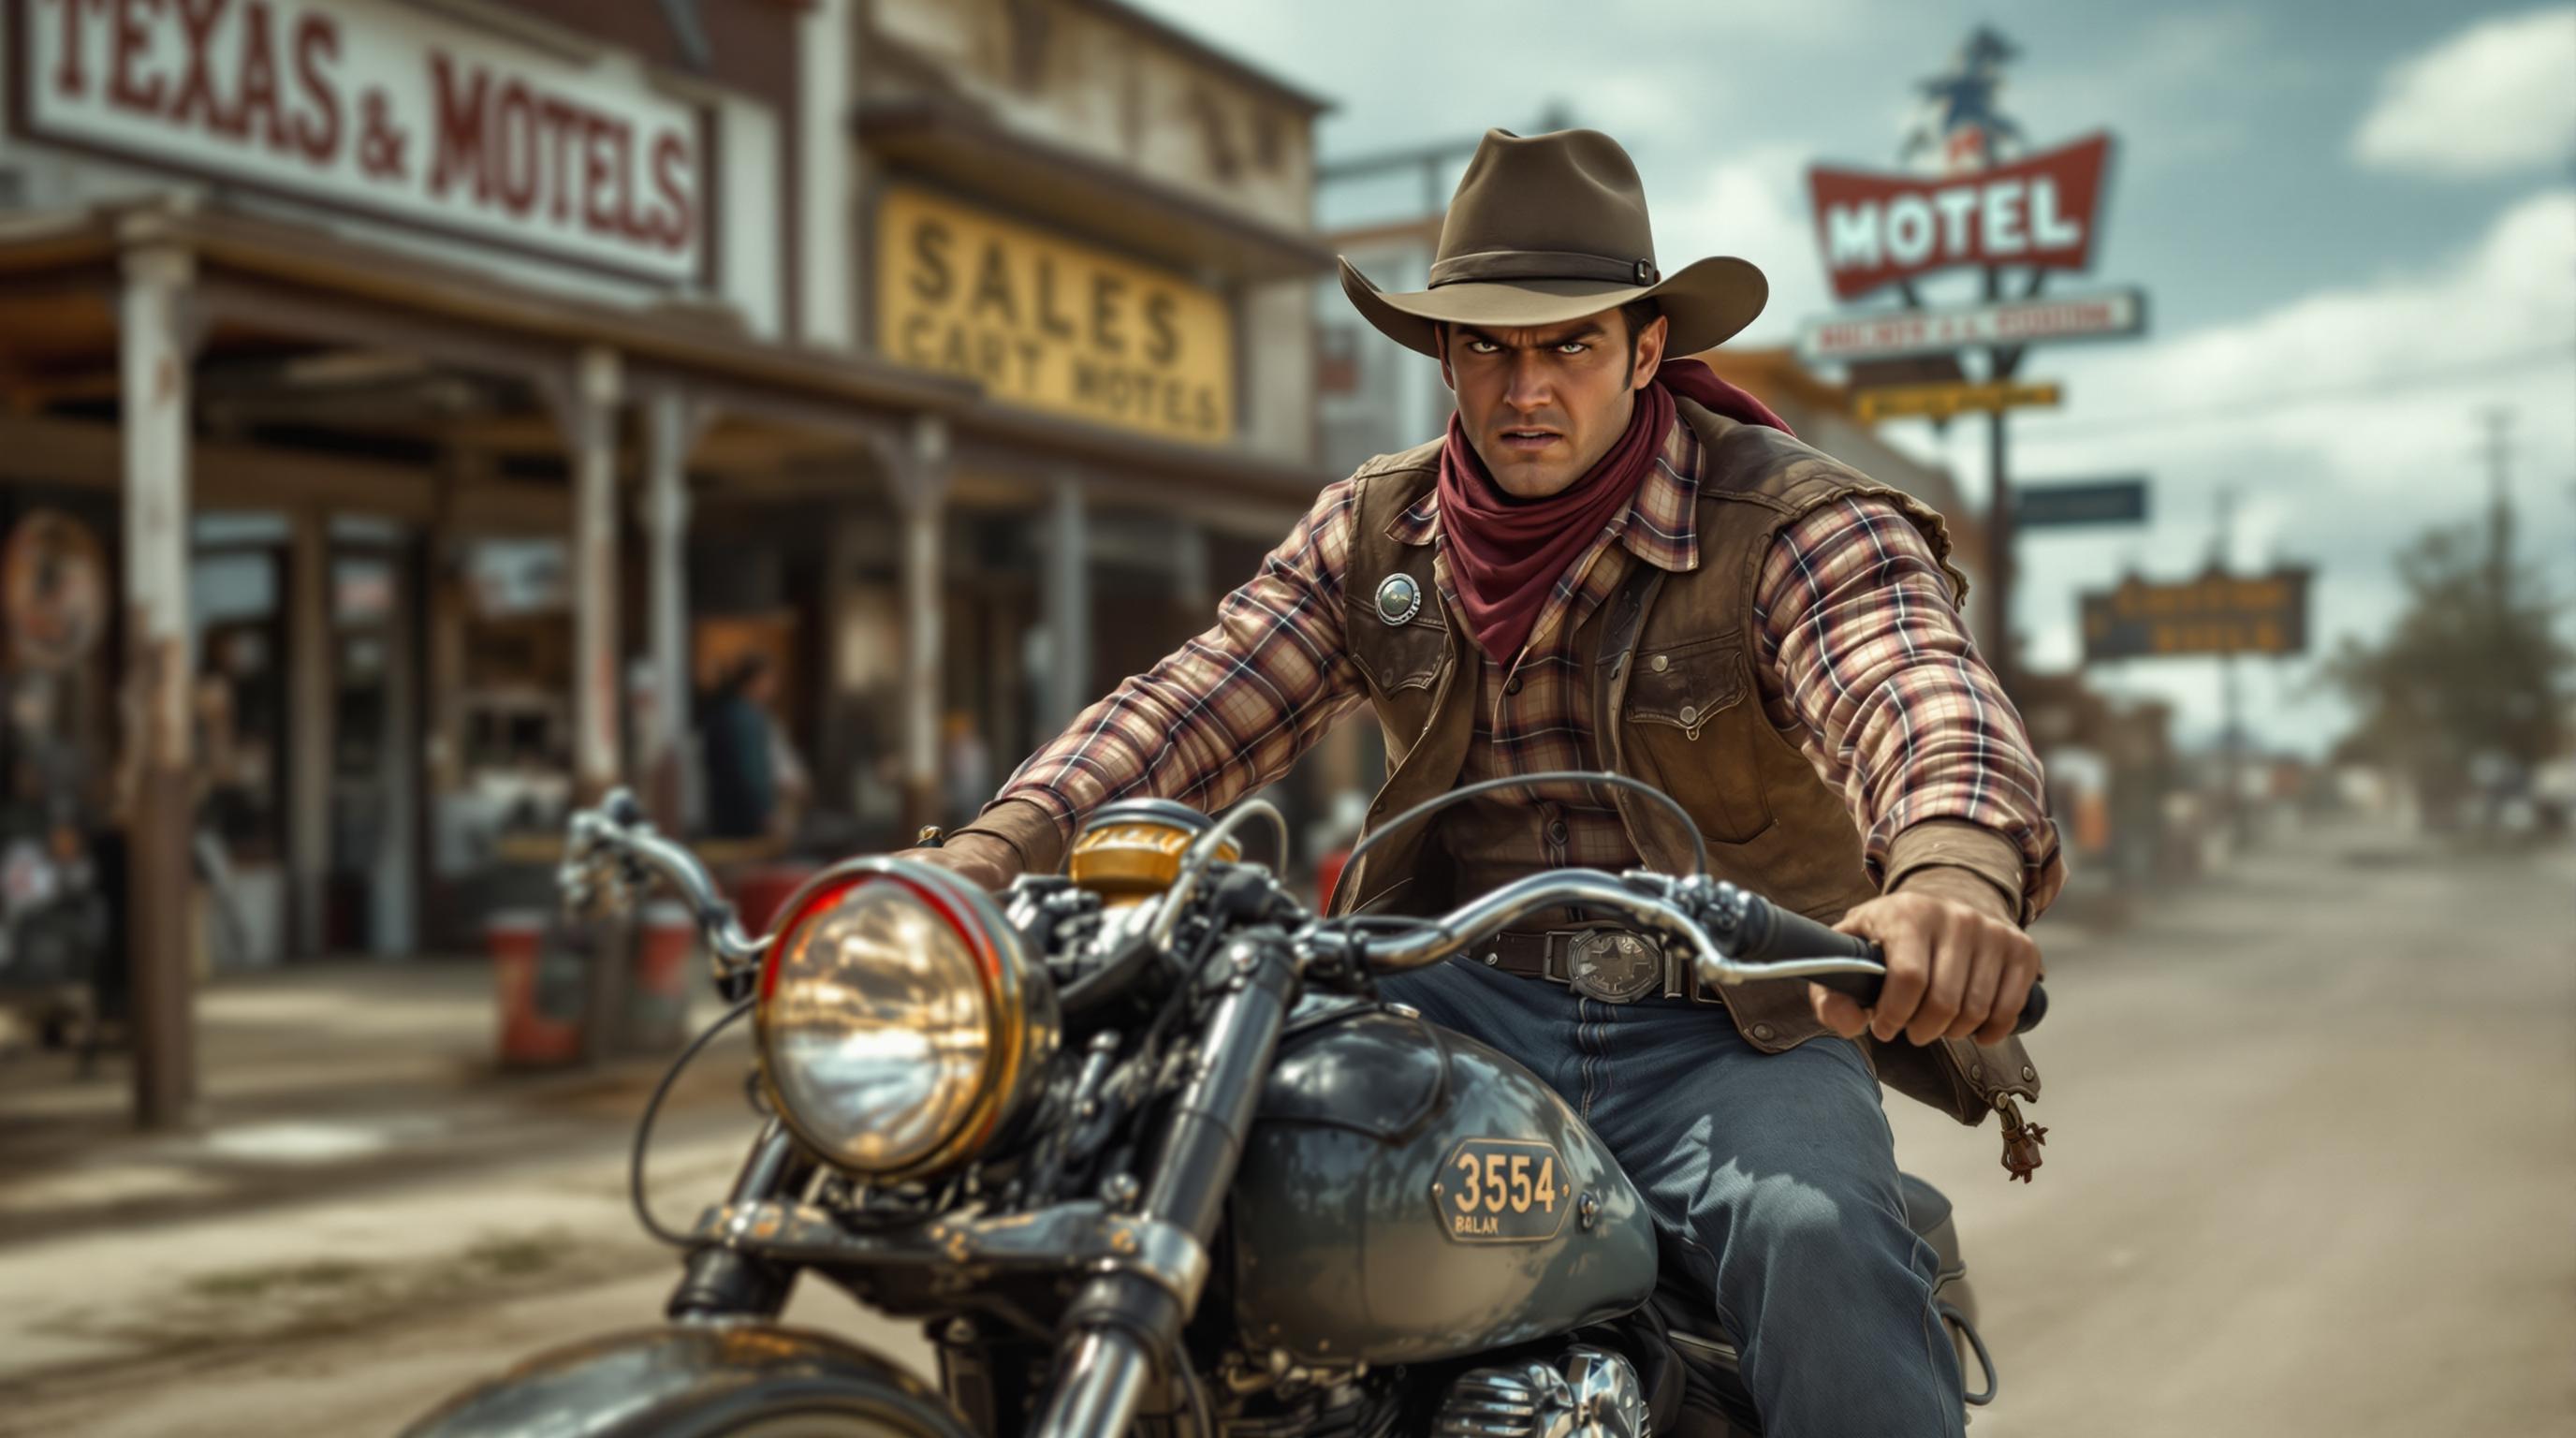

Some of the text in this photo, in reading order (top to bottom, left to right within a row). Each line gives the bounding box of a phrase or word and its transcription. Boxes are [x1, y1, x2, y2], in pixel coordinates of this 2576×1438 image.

[42, 0, 695, 254] TEXAS & MOTELS
[1828, 178, 2081, 267] MOTEL
[907, 217, 1183, 365] SALES
[1455, 1152, 1556, 1213] 3554
